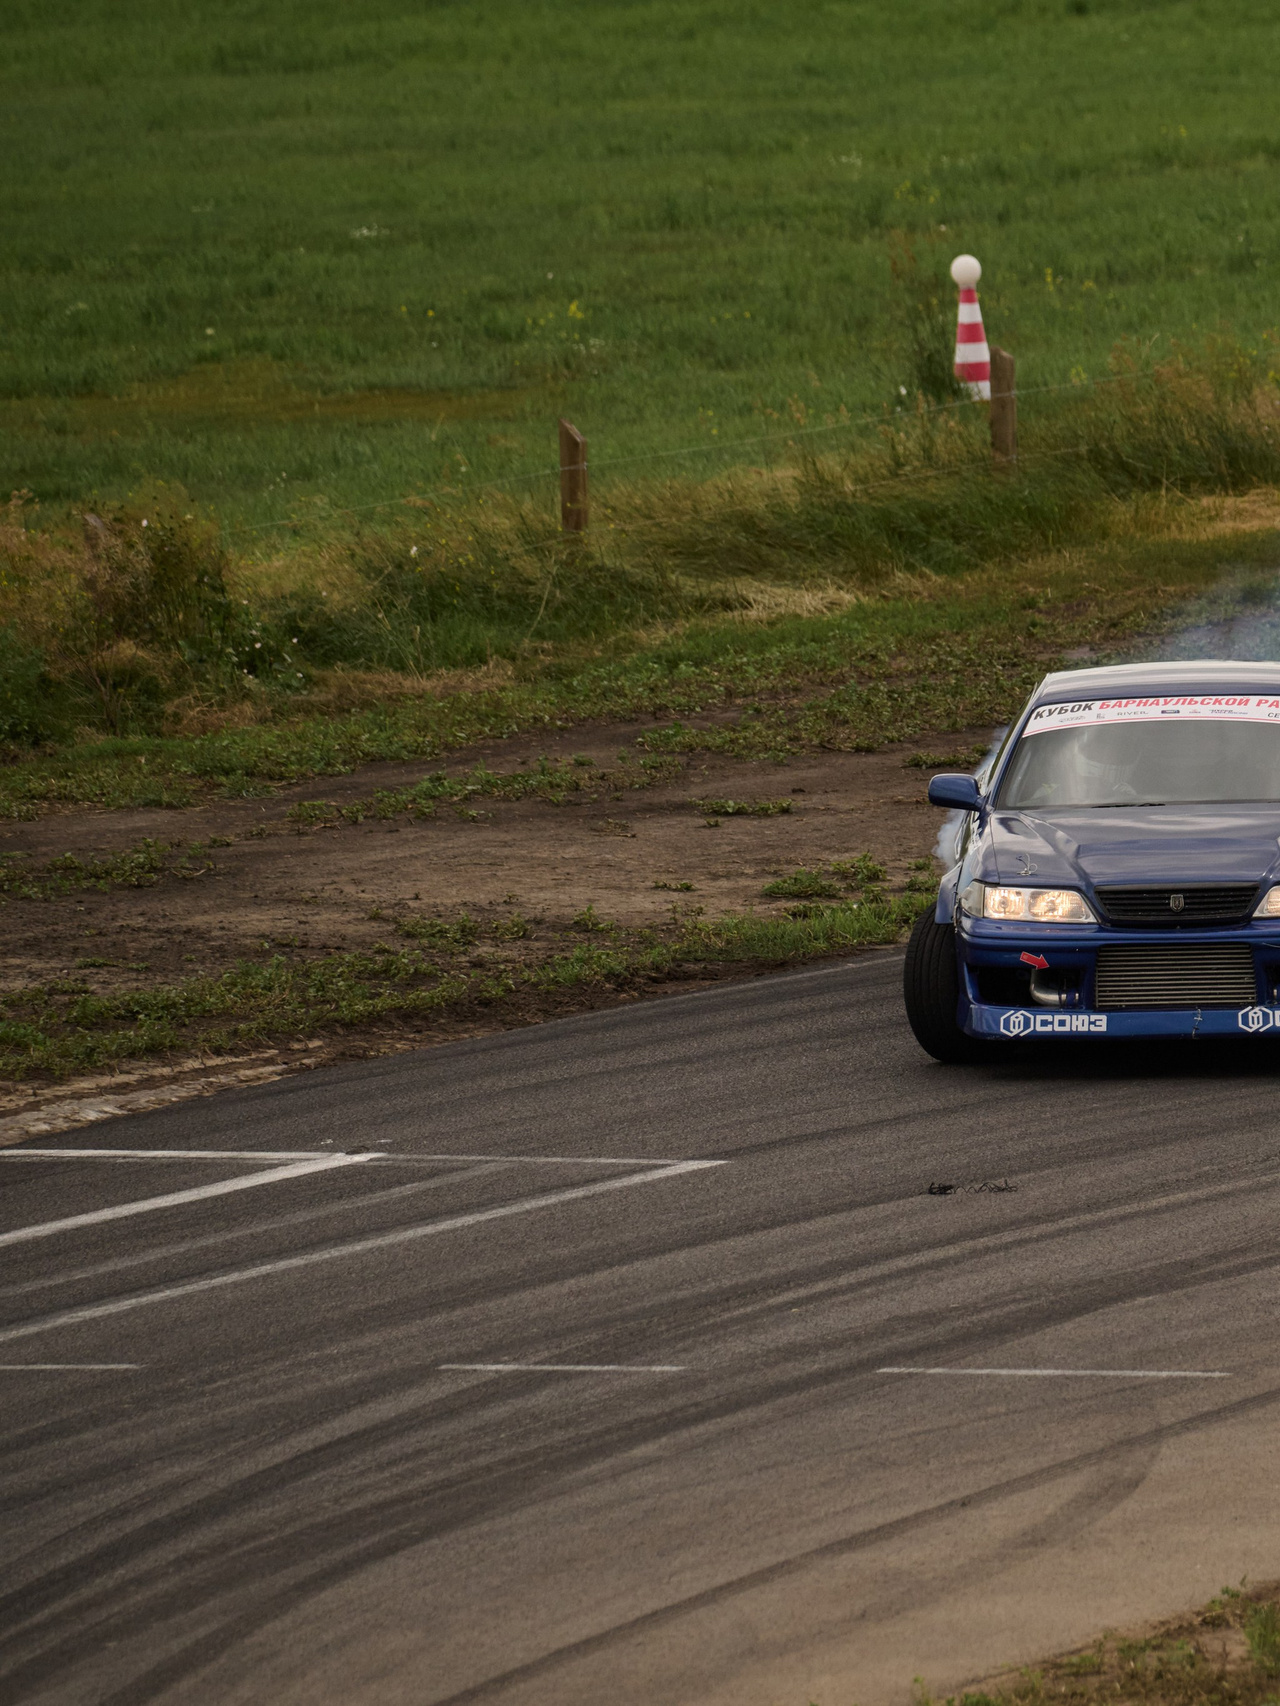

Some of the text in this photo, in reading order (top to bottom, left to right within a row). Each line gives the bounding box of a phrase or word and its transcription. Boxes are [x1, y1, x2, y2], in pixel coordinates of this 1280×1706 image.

[1033, 702, 1095, 721] КУБОК
[1099, 696, 1251, 710] БАРНАУЛЬСКОЙ
[1035, 1014, 1108, 1032] СОЮЗ
